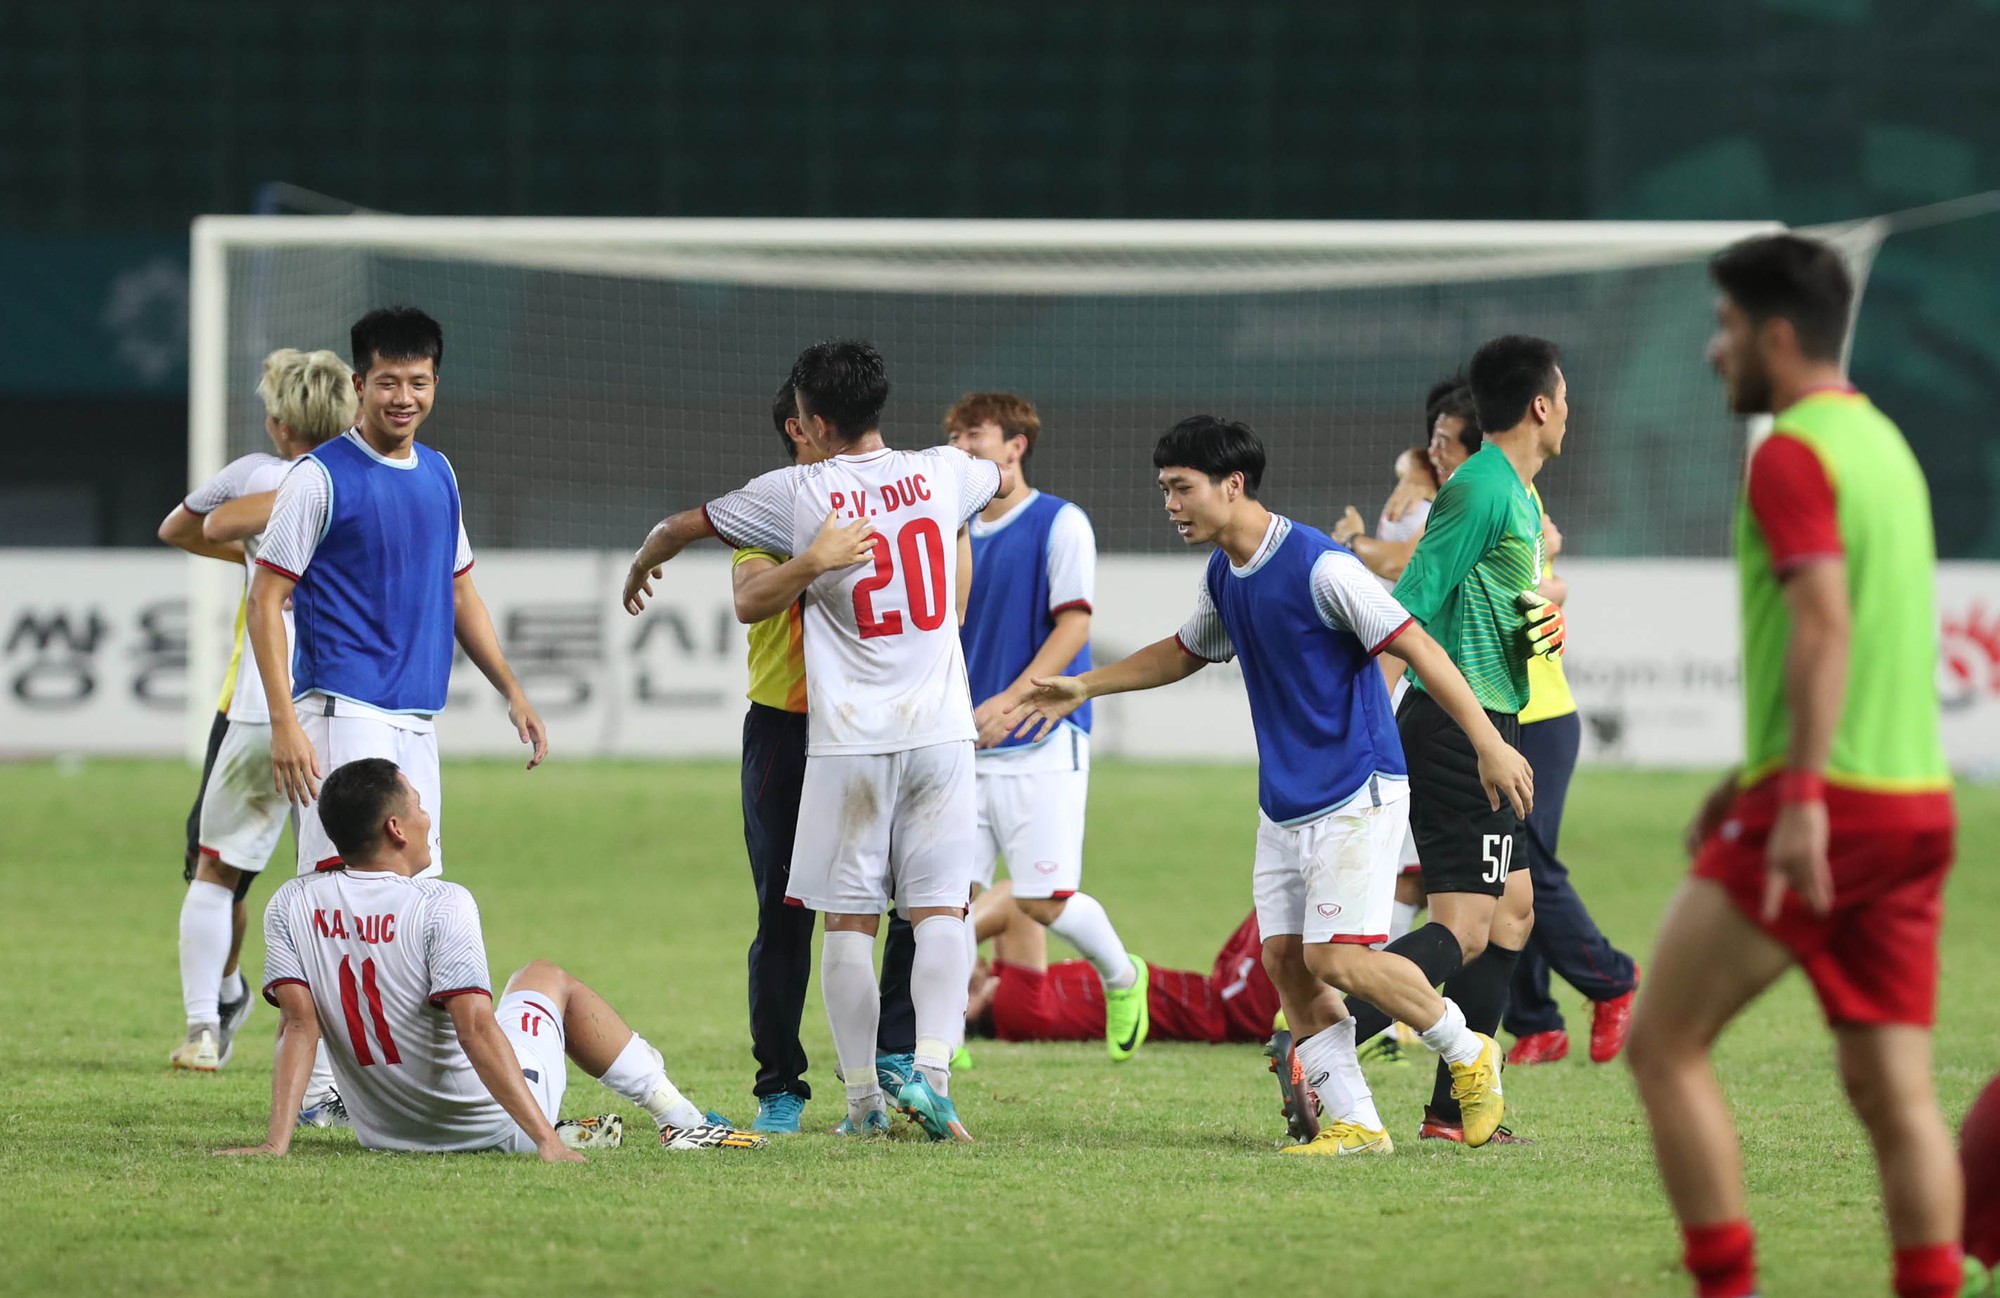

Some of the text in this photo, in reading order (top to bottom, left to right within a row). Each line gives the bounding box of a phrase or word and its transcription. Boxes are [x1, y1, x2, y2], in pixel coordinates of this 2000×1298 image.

[880, 473, 931, 512] DUC
[852, 517, 946, 639] 20
[1482, 834, 1513, 883] 50
[339, 954, 402, 1066] 11
[1291, 1054, 1304, 1085] didas
